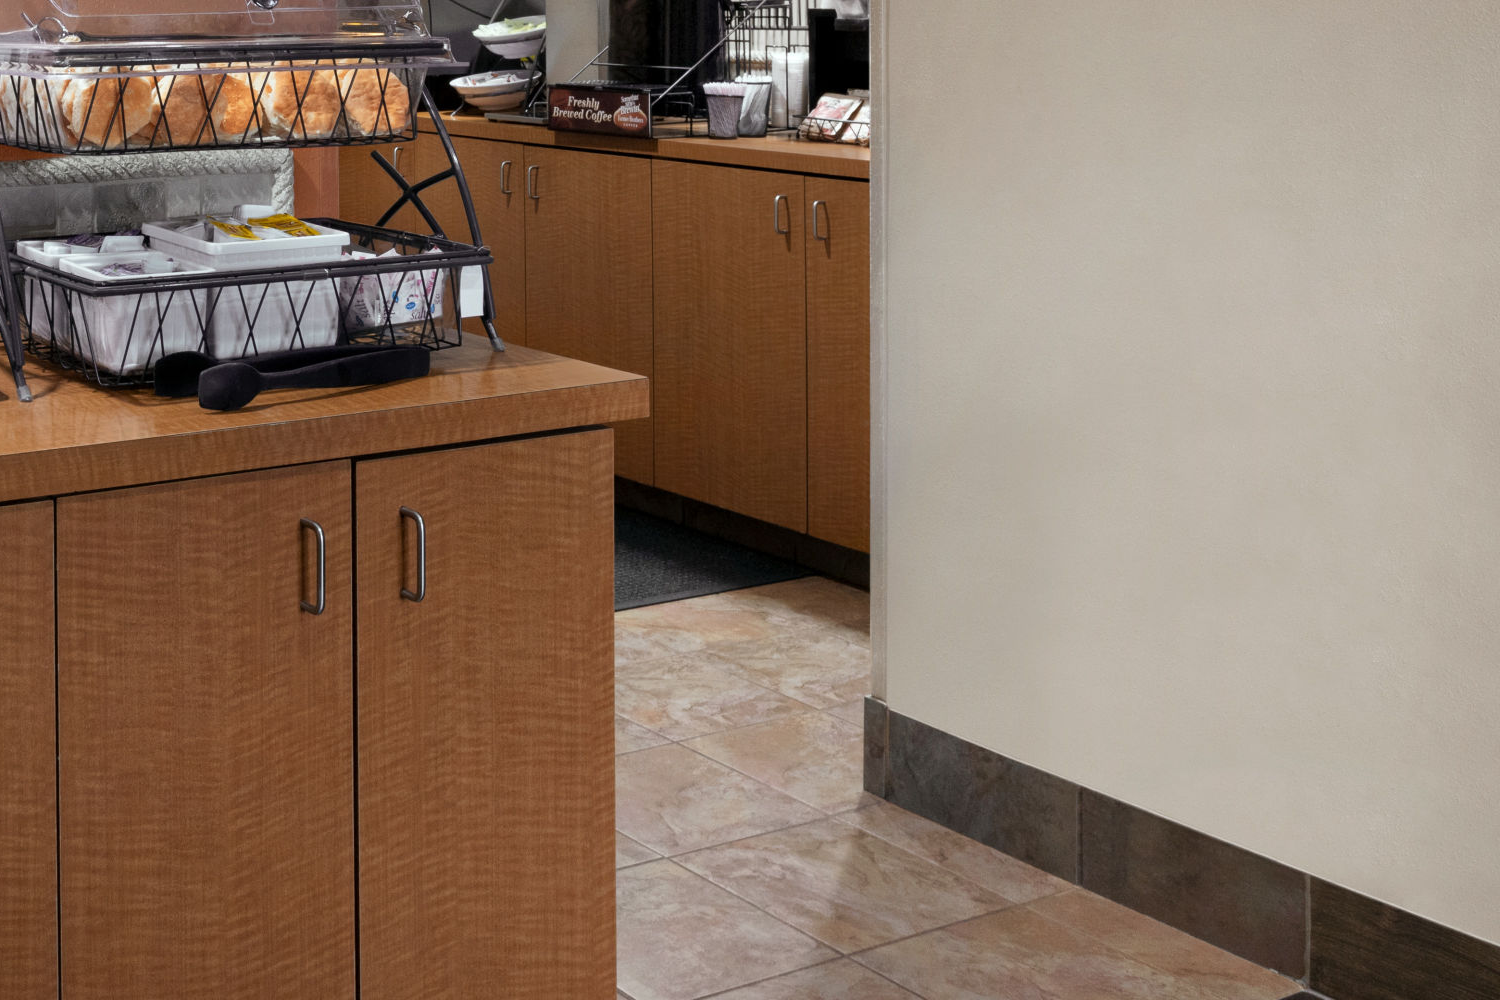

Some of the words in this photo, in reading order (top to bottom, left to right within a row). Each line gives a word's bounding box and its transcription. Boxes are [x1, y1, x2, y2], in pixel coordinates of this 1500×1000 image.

[568, 96, 600, 110] Freshly
[553, 107, 584, 119] Brewed
[585, 110, 612, 123] Coffee
